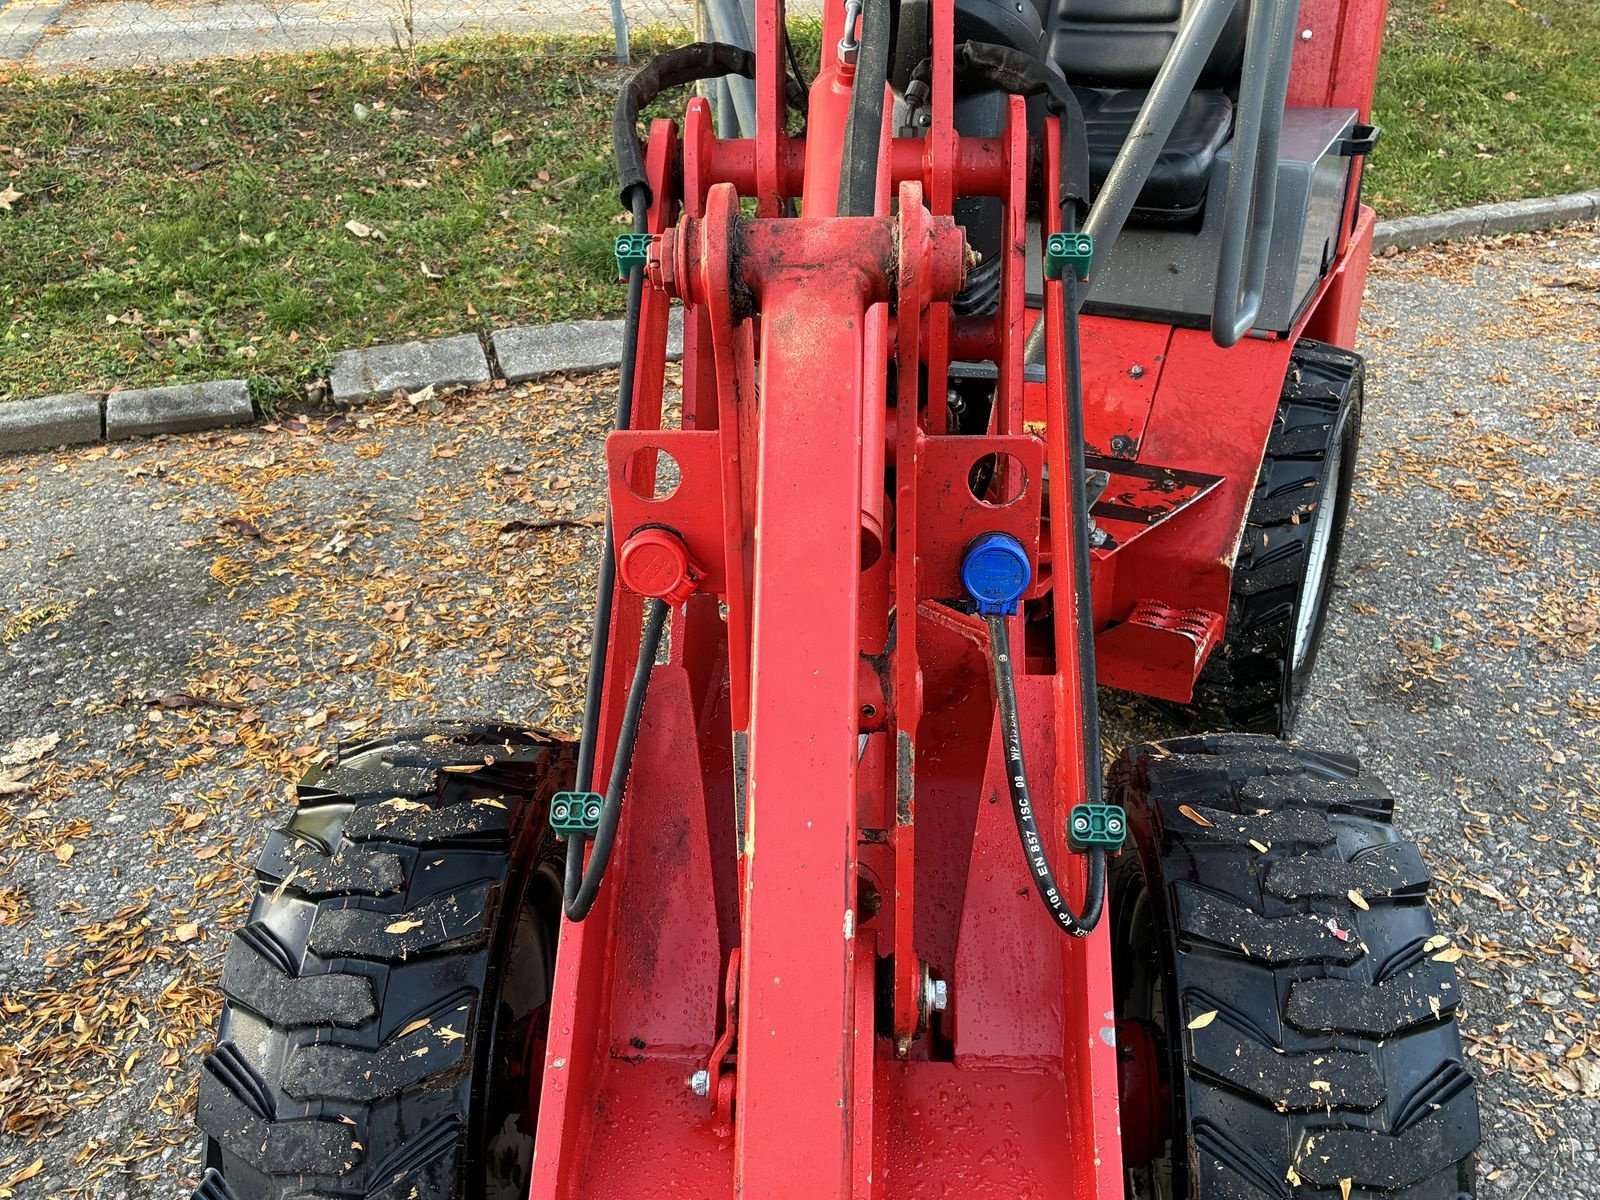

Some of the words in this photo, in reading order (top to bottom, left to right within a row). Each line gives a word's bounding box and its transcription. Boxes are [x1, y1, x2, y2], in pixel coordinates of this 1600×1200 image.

[1010, 747, 1021, 761] WP
[1014, 775, 1025, 788] 08
[1018, 798, 1032, 821] 1SC
[1026, 830, 1040, 853] 857
[1034, 856, 1048, 876] EN
[1046, 888, 1061, 909] 108
[1058, 912, 1073, 926] KP
